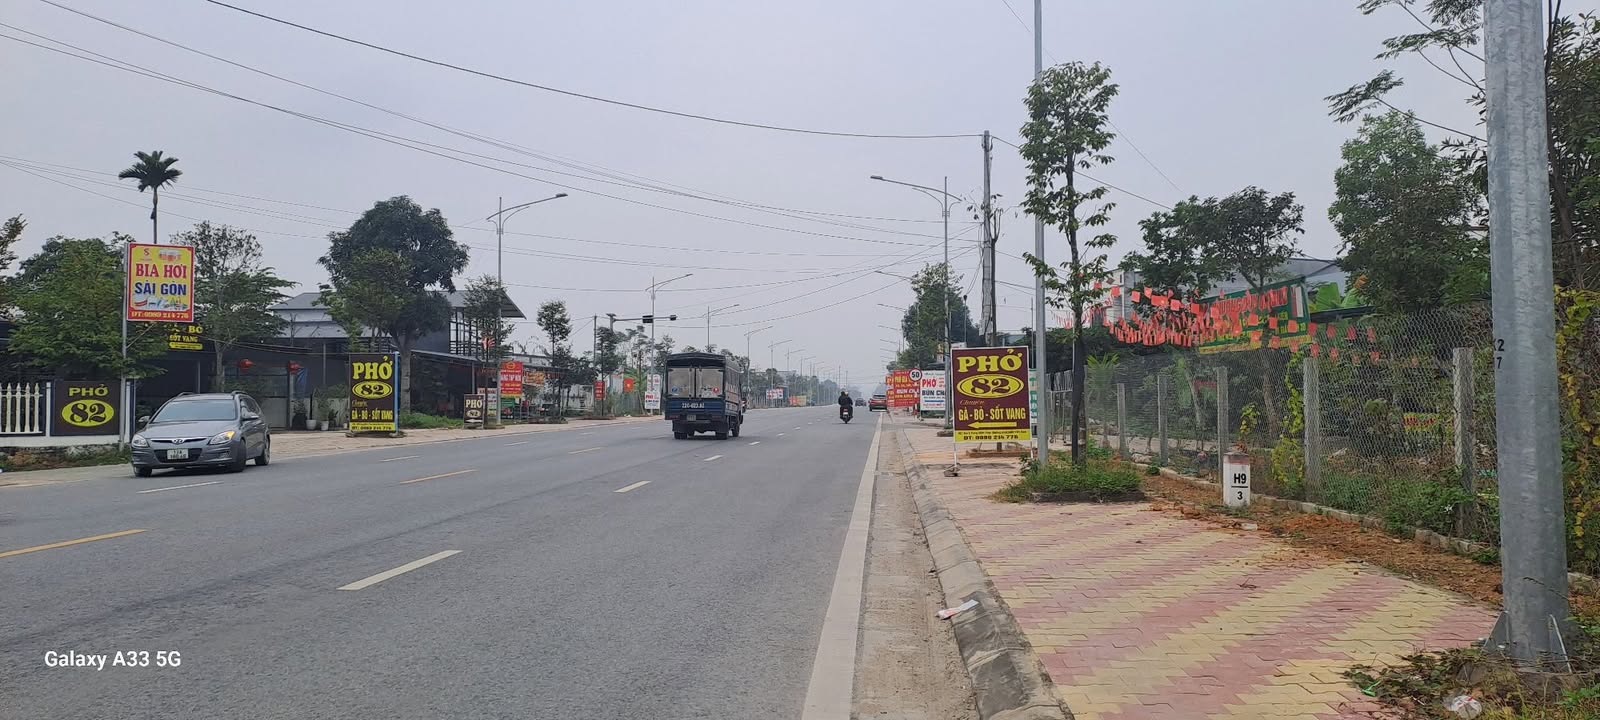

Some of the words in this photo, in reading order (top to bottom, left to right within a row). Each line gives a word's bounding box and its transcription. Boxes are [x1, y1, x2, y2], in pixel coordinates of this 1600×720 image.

[136, 264, 159, 277] BIA
[164, 264, 187, 278] HƠI
[134, 280, 156, 294] SÀI
[160, 281, 186, 295] GÒN
[956, 348, 1022, 372] PHỞ
[352, 356, 393, 380] PHỞ
[922, 376, 937, 387] PHỞ
[971, 378, 1010, 394] 82
[69, 384, 108, 396] PHỞ
[361, 385, 384, 395] 82
[70, 403, 106, 423] 82
[959, 407, 969, 420] GÀ
[974, 405, 984, 420] BÒ
[990, 404, 1004, 420] SỐT
[1006, 408, 1026, 419] VANG
[1234, 473, 1246, 484] H9
[1237, 491, 1243, 500] 3
